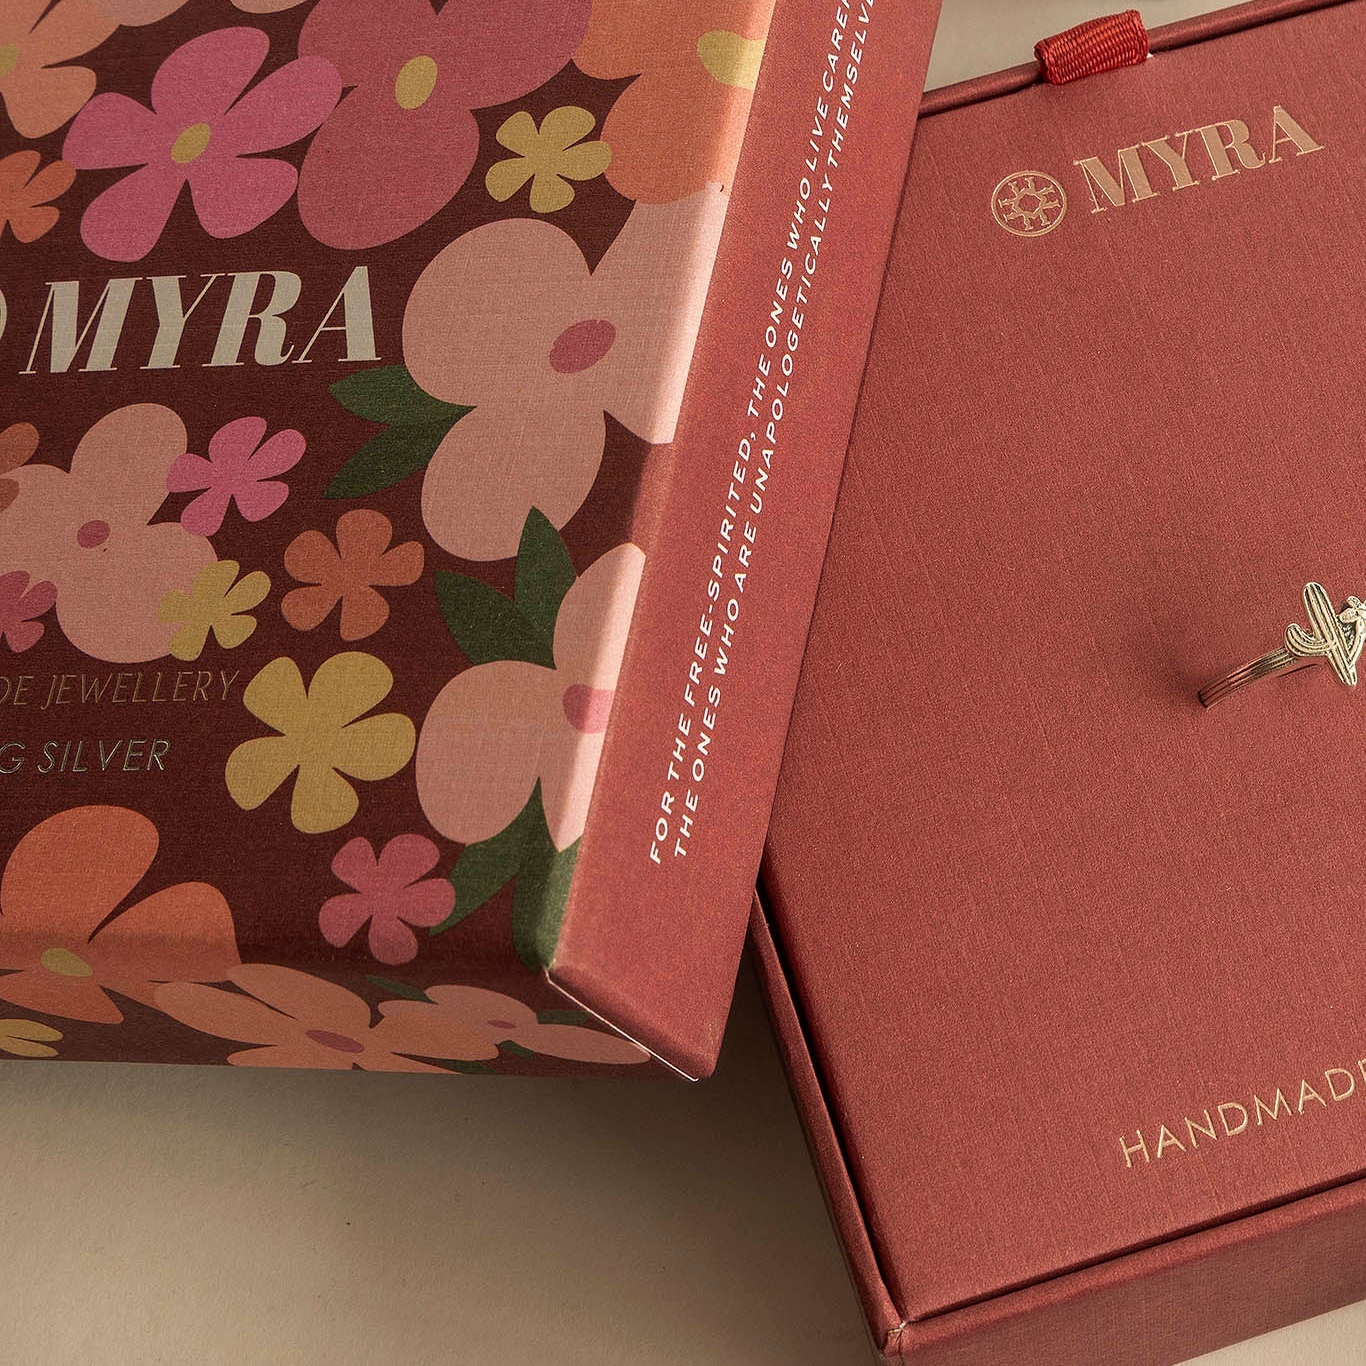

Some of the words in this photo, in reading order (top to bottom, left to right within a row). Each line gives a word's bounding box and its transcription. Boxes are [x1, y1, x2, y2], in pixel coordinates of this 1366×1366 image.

[1073, 105, 1326, 214] MYRA
[18, 265, 382, 376] MYRA
[649, 791, 675, 864] FOR
[667, 718, 692, 782] THE
[684, 431, 757, 708] FREE-SPIRITED,
[747, 352, 772, 421] THE
[765, 259, 793, 348] ONES
[786, 177, 811, 250] WHO
[804, 97, 828, 169] LIVE
[674, 789, 698, 857] THE
[692, 686, 722, 782] ONES
[713, 599, 739, 678] WHO
[734, 521, 757, 593] ARE
[749, 173, 833, 514] UNAPOLOGETICALLY
[40, 669, 240, 710] JEWELLERY
[37, 739, 172, 774] SILVER
